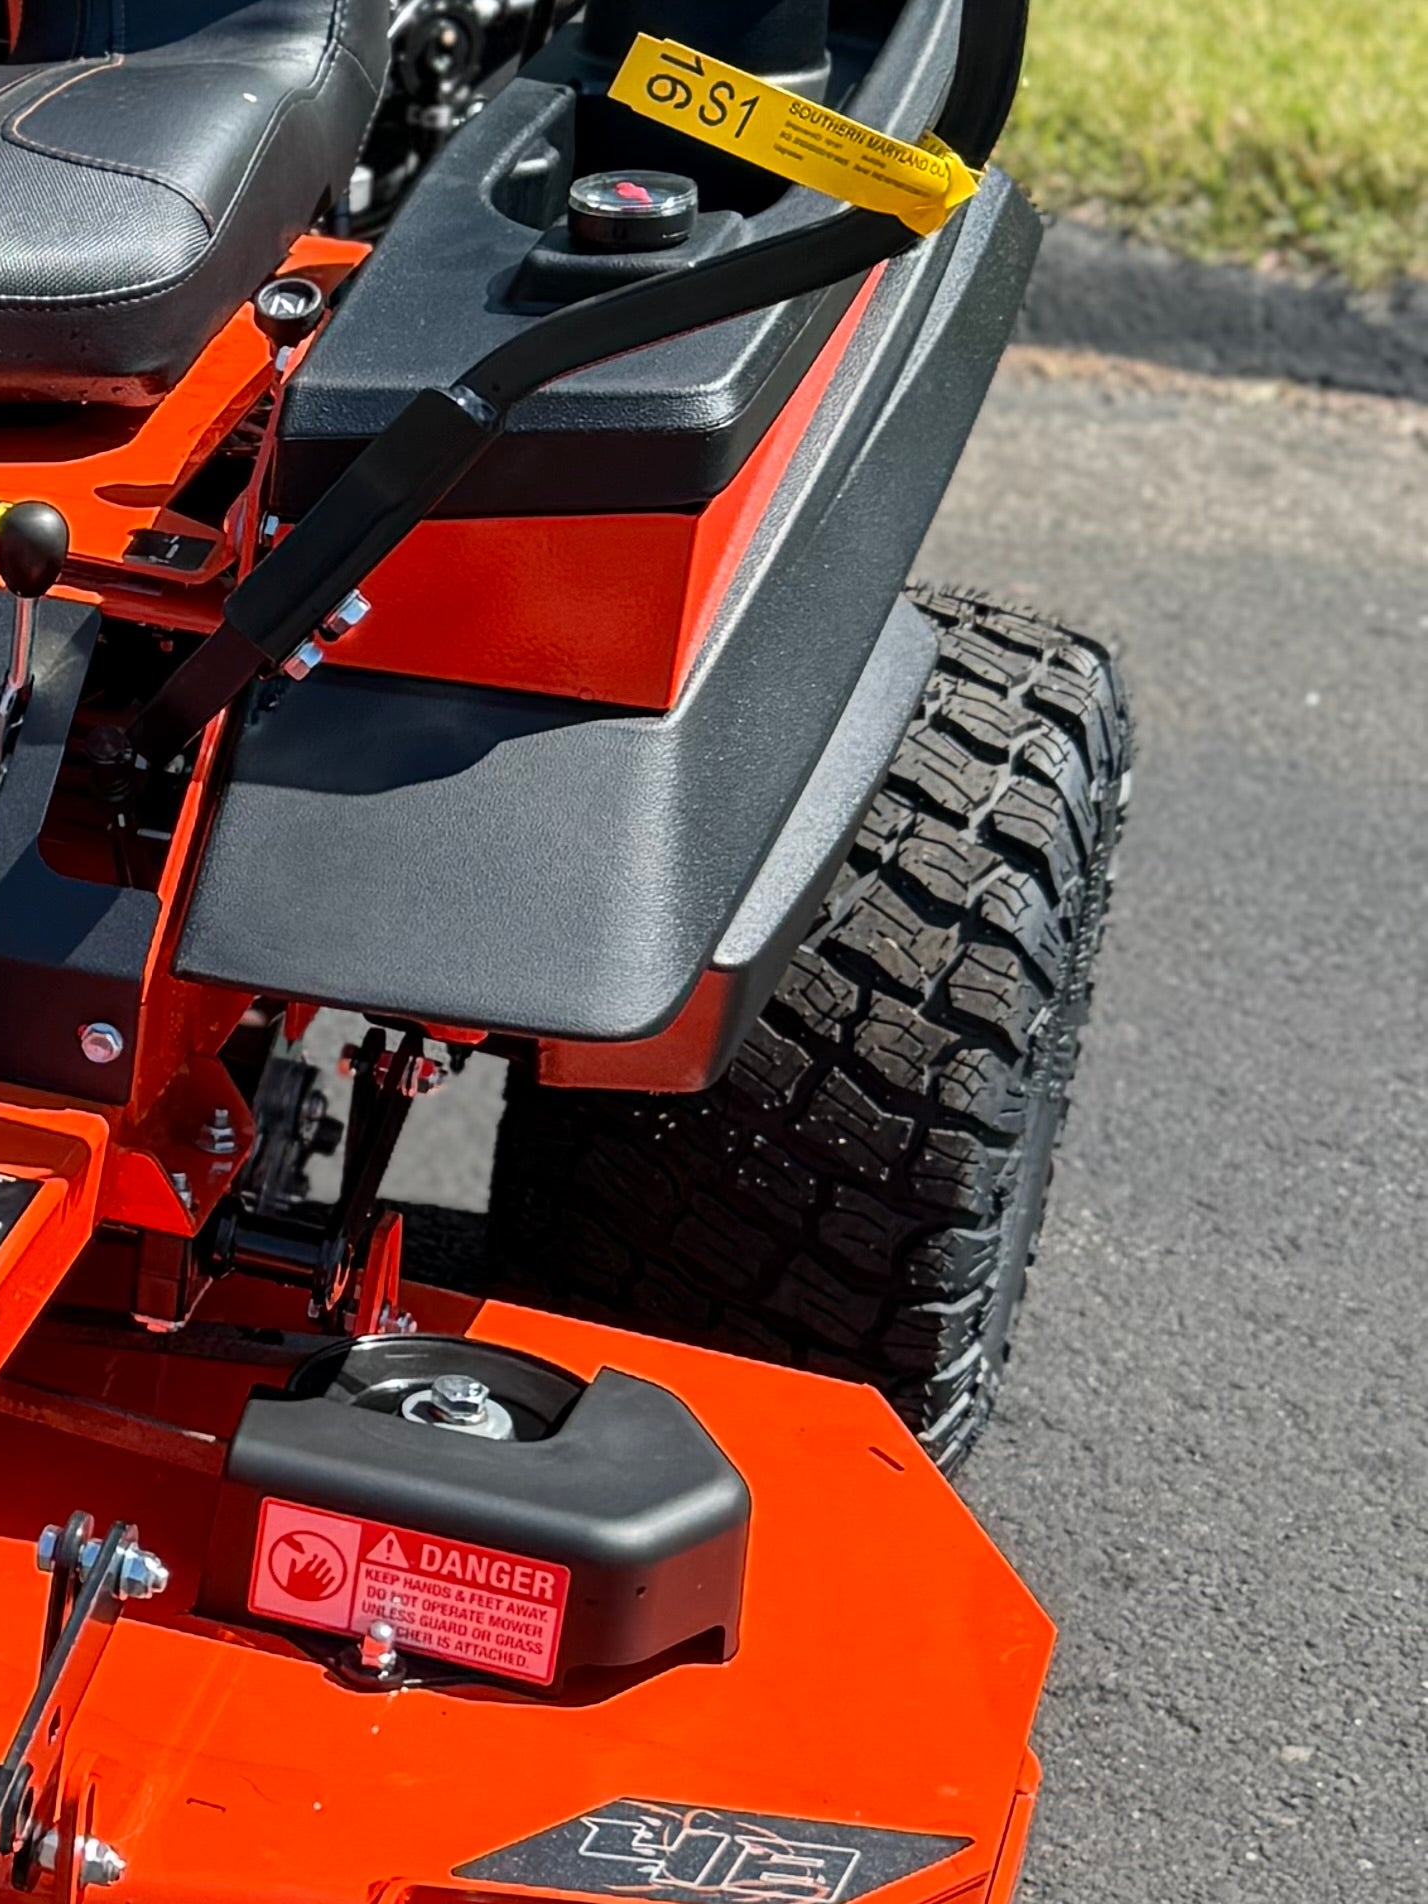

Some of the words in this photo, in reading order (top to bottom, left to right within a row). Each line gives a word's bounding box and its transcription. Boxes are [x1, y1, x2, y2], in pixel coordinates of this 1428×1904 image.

[698, 80, 760, 138] S1
[788, 101, 865, 145] SOUTHERN
[867, 137, 929, 173] MARYLAND
[364, 1567, 401, 1586] KEEP
[403, 1577, 452, 1599] HANDS
[454, 1589, 466, 1603] &
[469, 1592, 502, 1612] FEET
[506, 1602, 548, 1623] AWAY.
[419, 1543, 556, 1600] DANGER
[361, 1600, 416, 1624] UNLESS
[419, 1613, 467, 1637] GUARD
[471, 1628, 491, 1643] OR
[495, 1634, 543, 1656] GRASS
[366, 1585, 386, 1601] DO
[421, 1598, 489, 1624] OPERATE
[489, 1615, 543, 1639] MOWER
[436, 1634, 451, 1649] IS
[454, 1639, 530, 1669] ATTACHED.
